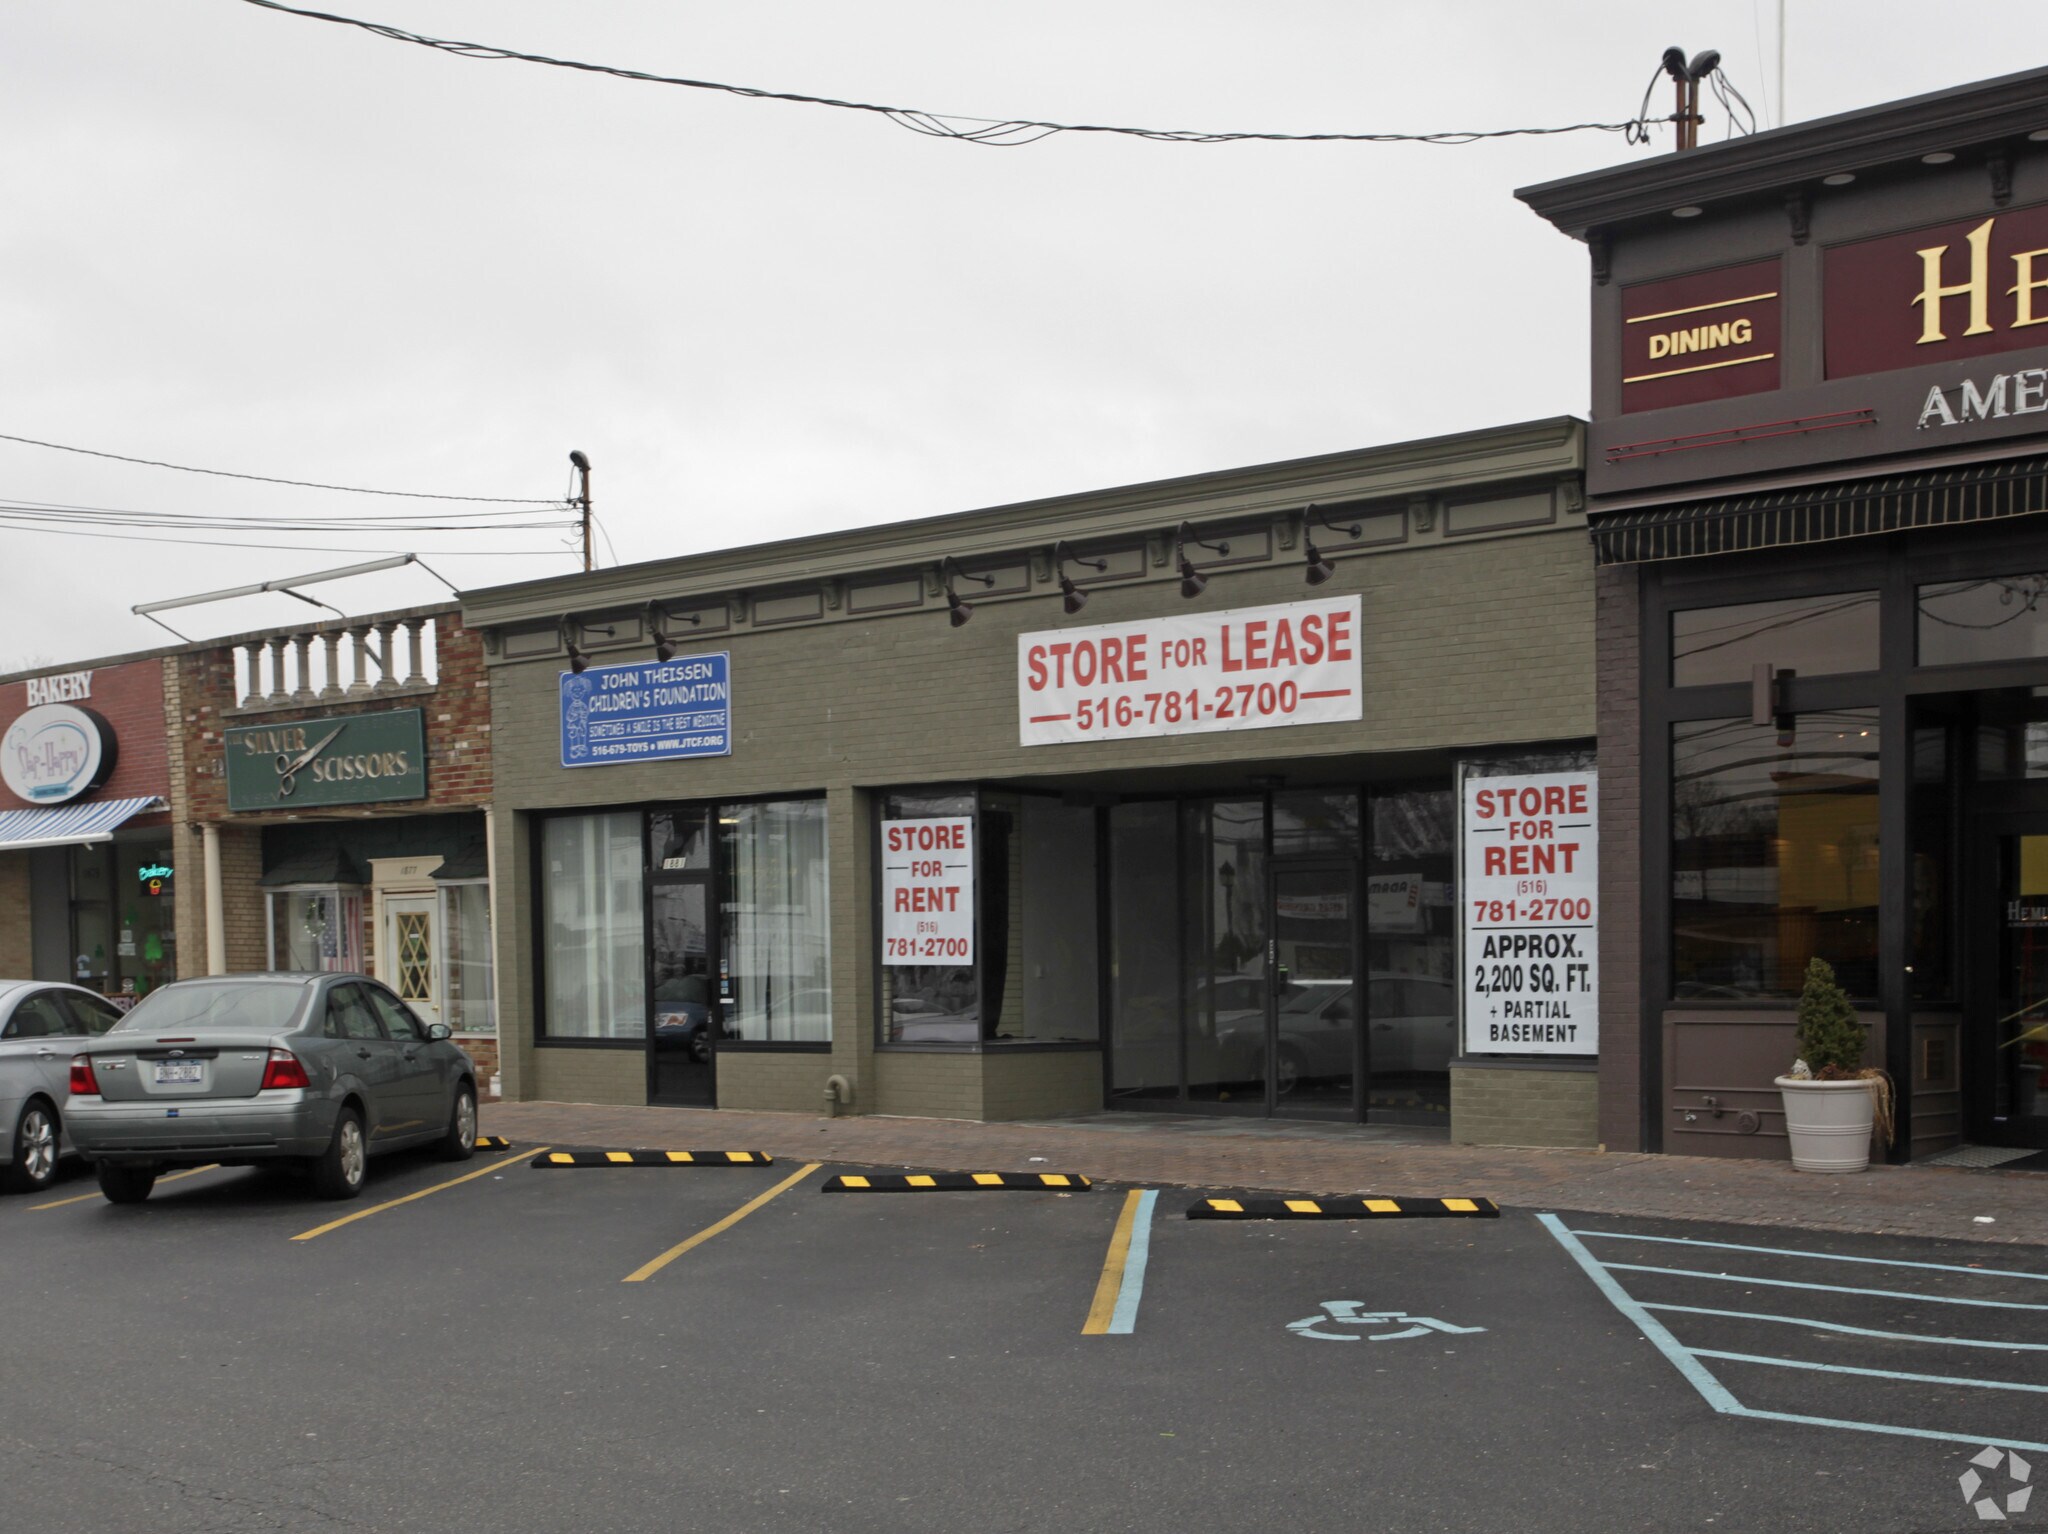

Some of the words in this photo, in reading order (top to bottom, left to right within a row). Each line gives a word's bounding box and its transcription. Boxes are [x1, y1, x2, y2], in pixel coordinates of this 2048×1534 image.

[1649, 318, 1752, 360] DINING
[1916, 368, 2048, 430] AME
[1028, 633, 1148, 692] STORE
[1161, 637, 1207, 670] FOR
[1221, 611, 1352, 673] LEASE
[26, 670, 94, 708] BAKERY
[601, 671, 639, 691] JOHN
[644, 663, 713, 684] THEISSEN
[588, 689, 650, 713] CHILDREN'S
[653, 682, 726, 707] FOUNDATION
[1077, 679, 1298, 731] 516-781-2700
[588, 722, 625, 738] SOMETIMES
[626, 723, 632, 734] A
[632, 719, 651, 734] SMILE
[652, 719, 661, 732] IS
[661, 718, 674, 731] THE
[675, 716, 691, 730] BEST
[692, 712, 726, 729] MEDICINE
[244, 727, 308, 756] SILVER
[656, 735, 724, 751] WWW.JTCF.ORG
[311, 751, 409, 783] SCISSORS
[1475, 784, 1589, 819] STORE
[888, 824, 965, 852] STORE
[1509, 819, 1554, 841] FOR
[139, 864, 174, 881] Bakery
[911, 860, 943, 878] FOR
[1484, 843, 1580, 876] RENT
[894, 886, 960, 913] RENT
[1516, 879, 1548, 897] (516)
[1473, 897, 1592, 922] 781-2700
[916, 921, 938, 935] (516)
[887, 937, 968, 956] 781-2700
[1482, 933, 1583, 959] APPROX.
[1475, 963, 1524, 998] 2,200
[1529, 963, 1560, 994] SQ.
[1566, 963, 1591, 993] FT.
[1504, 1000, 1571, 1019] PARTIAL
[1489, 1023, 1578, 1043] BASEMENT
